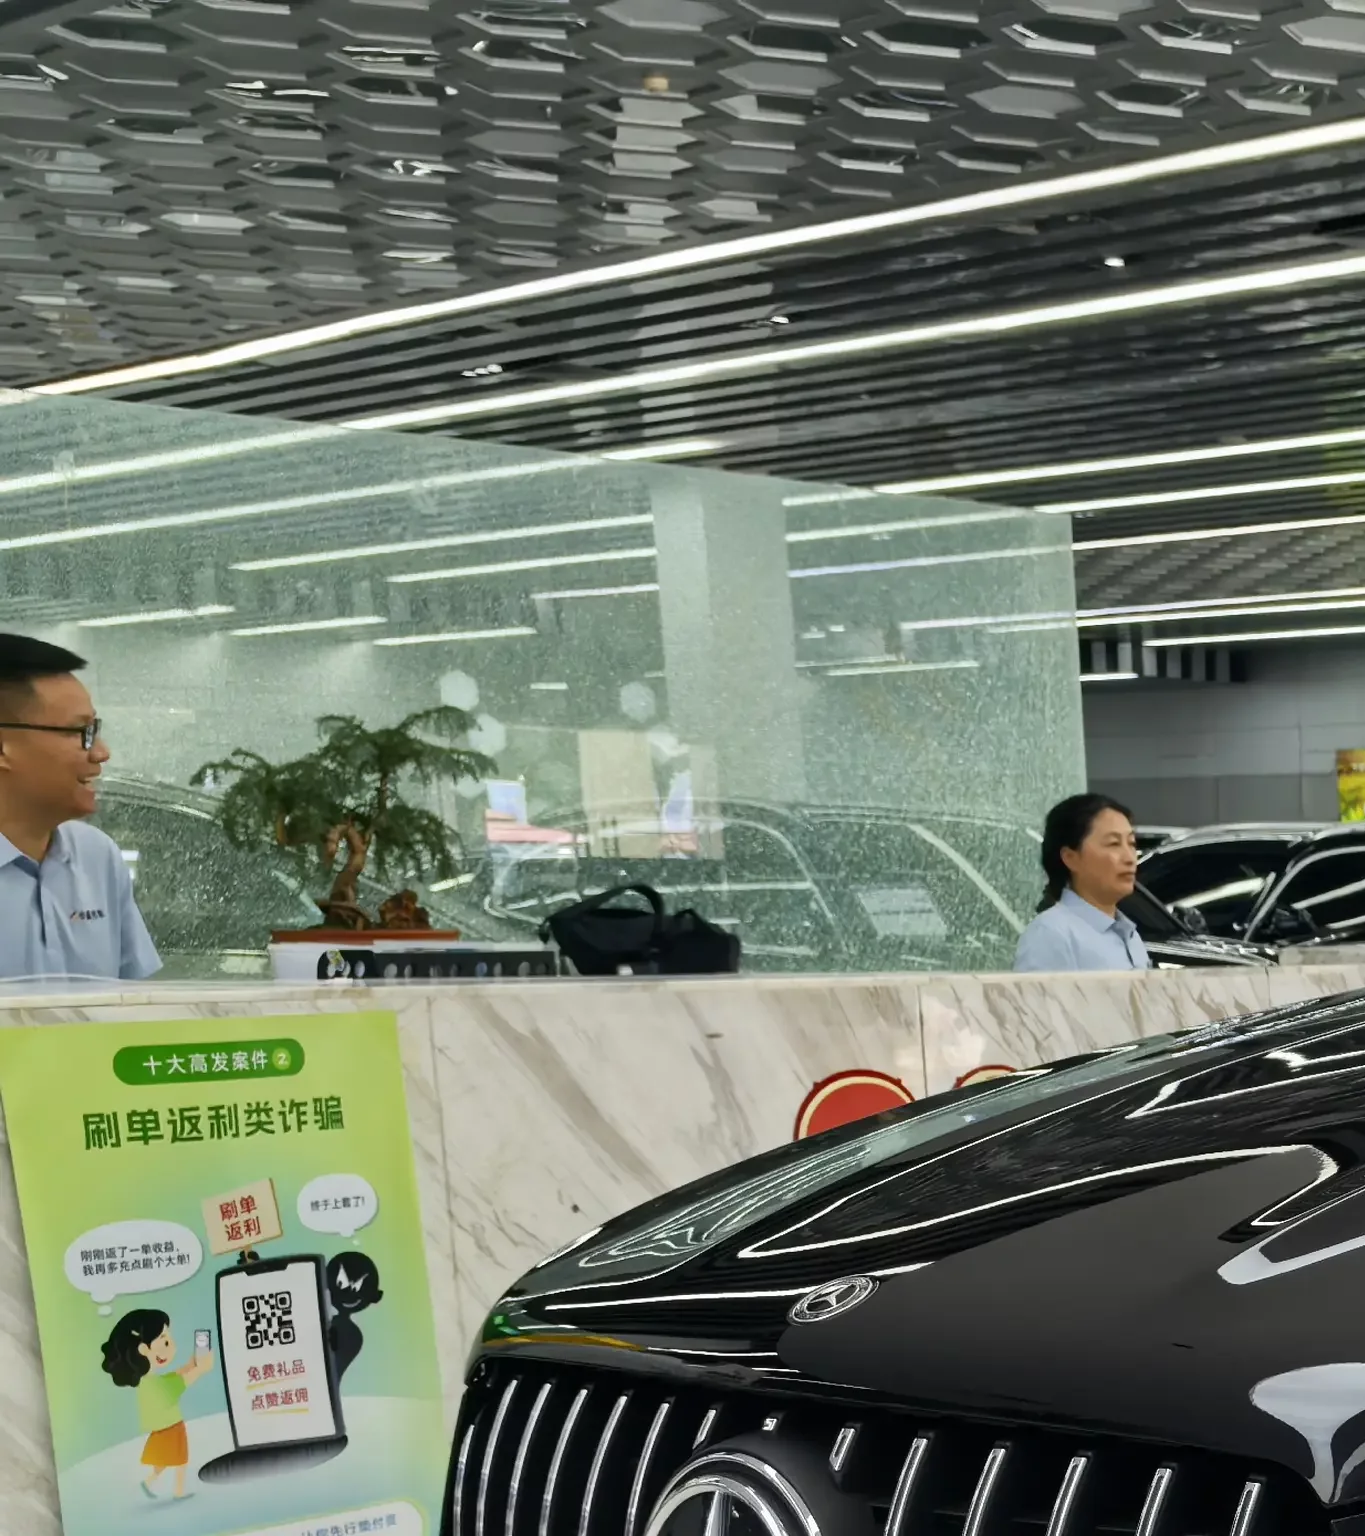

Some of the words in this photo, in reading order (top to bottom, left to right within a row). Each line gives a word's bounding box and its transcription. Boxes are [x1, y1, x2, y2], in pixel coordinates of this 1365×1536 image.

[142, 1049, 269, 1076] 十大高发案件
[82, 1095, 345, 1150] 刷单返利类诈骗
[219, 1195, 257, 1221] 刷单
[225, 1216, 261, 1242] 返利
[247, 1359, 306, 1383] 免费礼品
